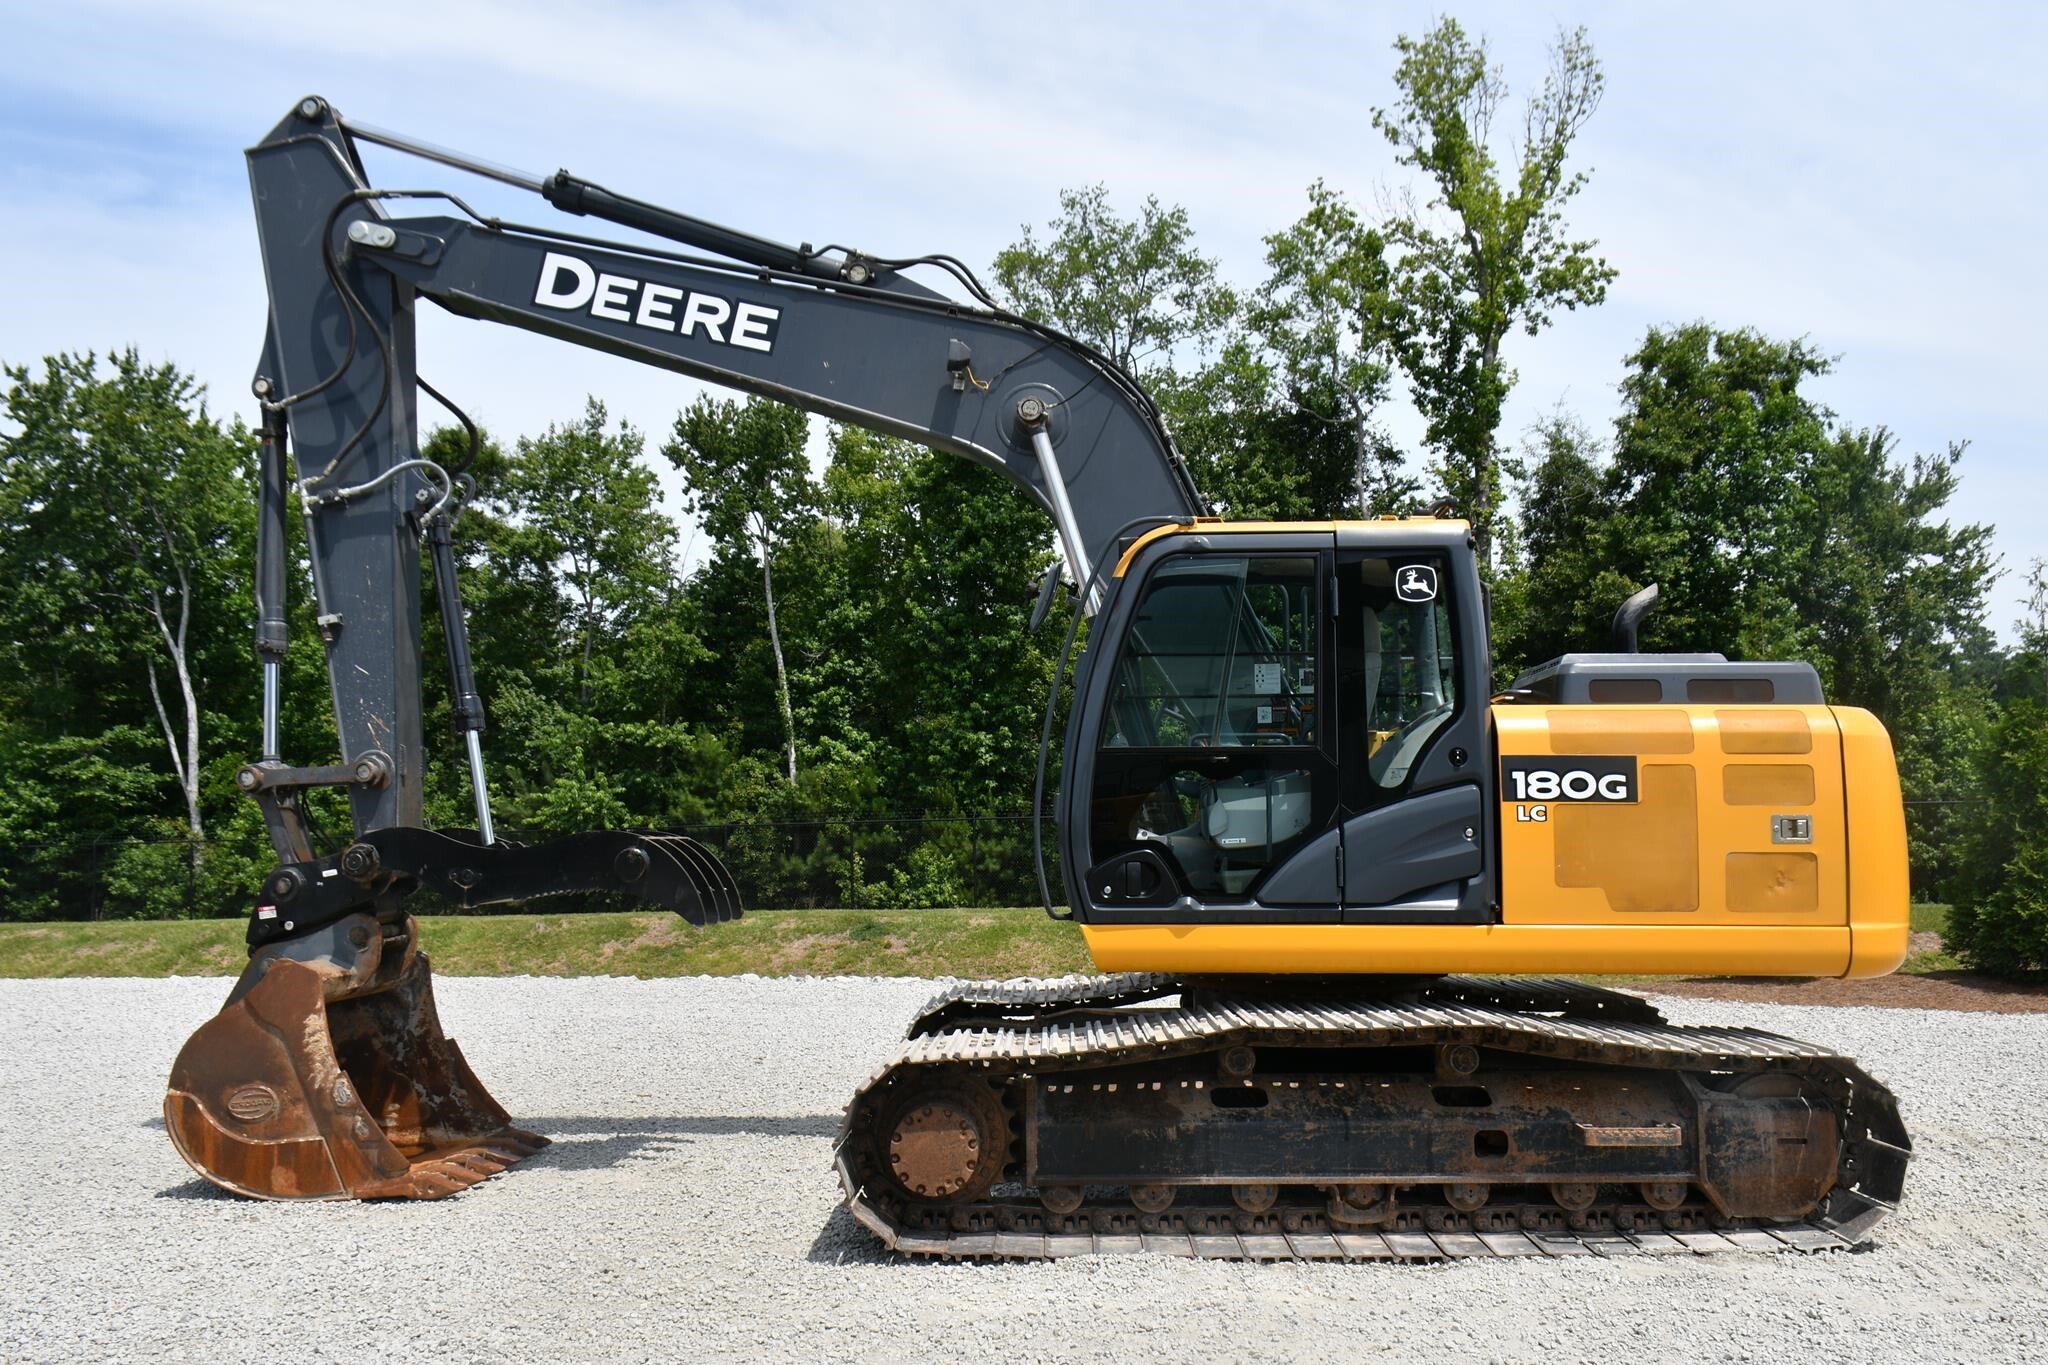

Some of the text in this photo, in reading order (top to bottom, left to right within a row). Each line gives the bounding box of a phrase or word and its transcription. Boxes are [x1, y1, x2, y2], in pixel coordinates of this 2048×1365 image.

[534, 251, 779, 352] DEERE
[1511, 770, 1627, 800] 180G
[1517, 805, 1547, 822] LC
